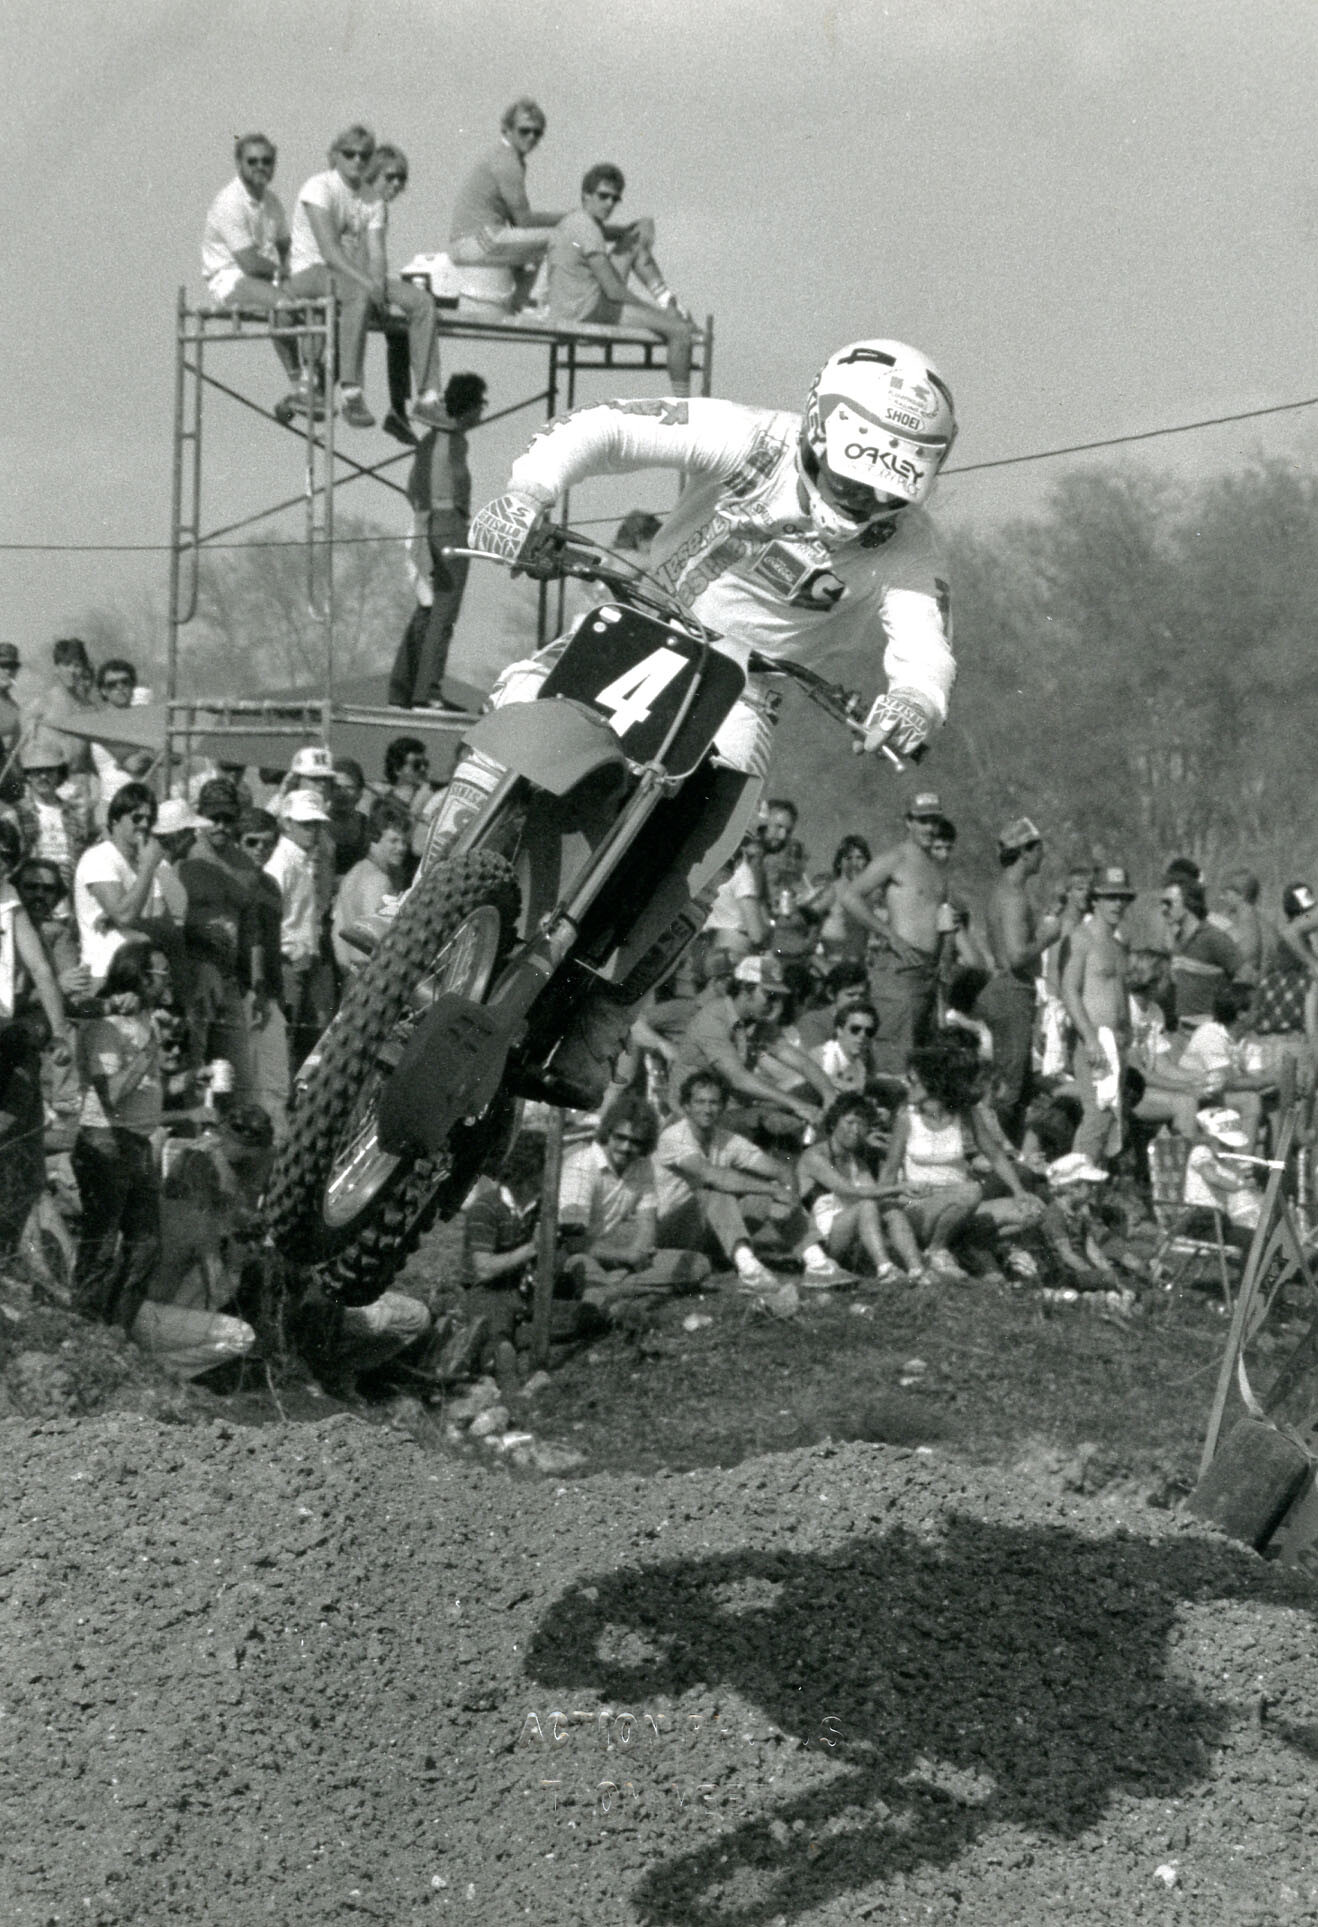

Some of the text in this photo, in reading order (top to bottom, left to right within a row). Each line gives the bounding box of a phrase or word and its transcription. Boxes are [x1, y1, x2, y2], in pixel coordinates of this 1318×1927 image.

[884, 407, 921, 431] SHOEI
[844, 443, 925, 485] OAKLEY
[594, 646, 690, 738] 4
